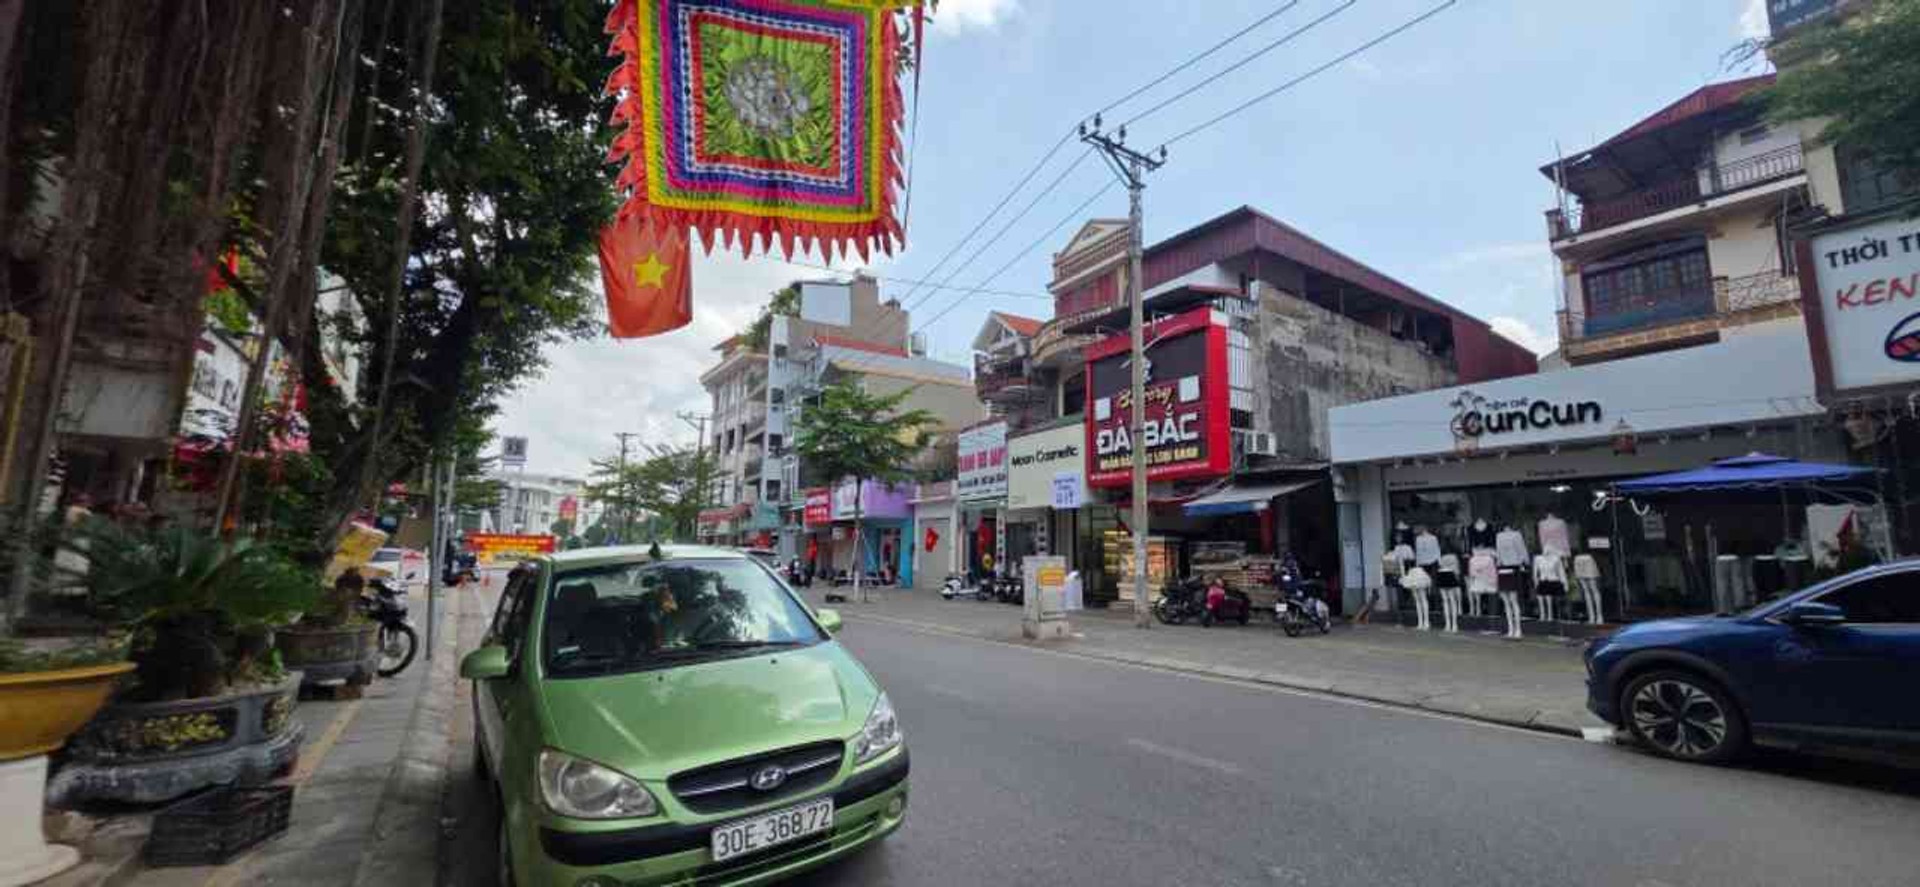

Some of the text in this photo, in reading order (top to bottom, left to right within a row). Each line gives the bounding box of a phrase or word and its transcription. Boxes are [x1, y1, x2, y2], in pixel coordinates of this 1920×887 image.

[1825, 236, 1888, 268] THỜI
[1144, 403, 1199, 447] BẮC
[1464, 400, 1602, 436] CunCun
[1011, 455, 1035, 467] Moon
[1036, 445, 1080, 463] Cosmetic
